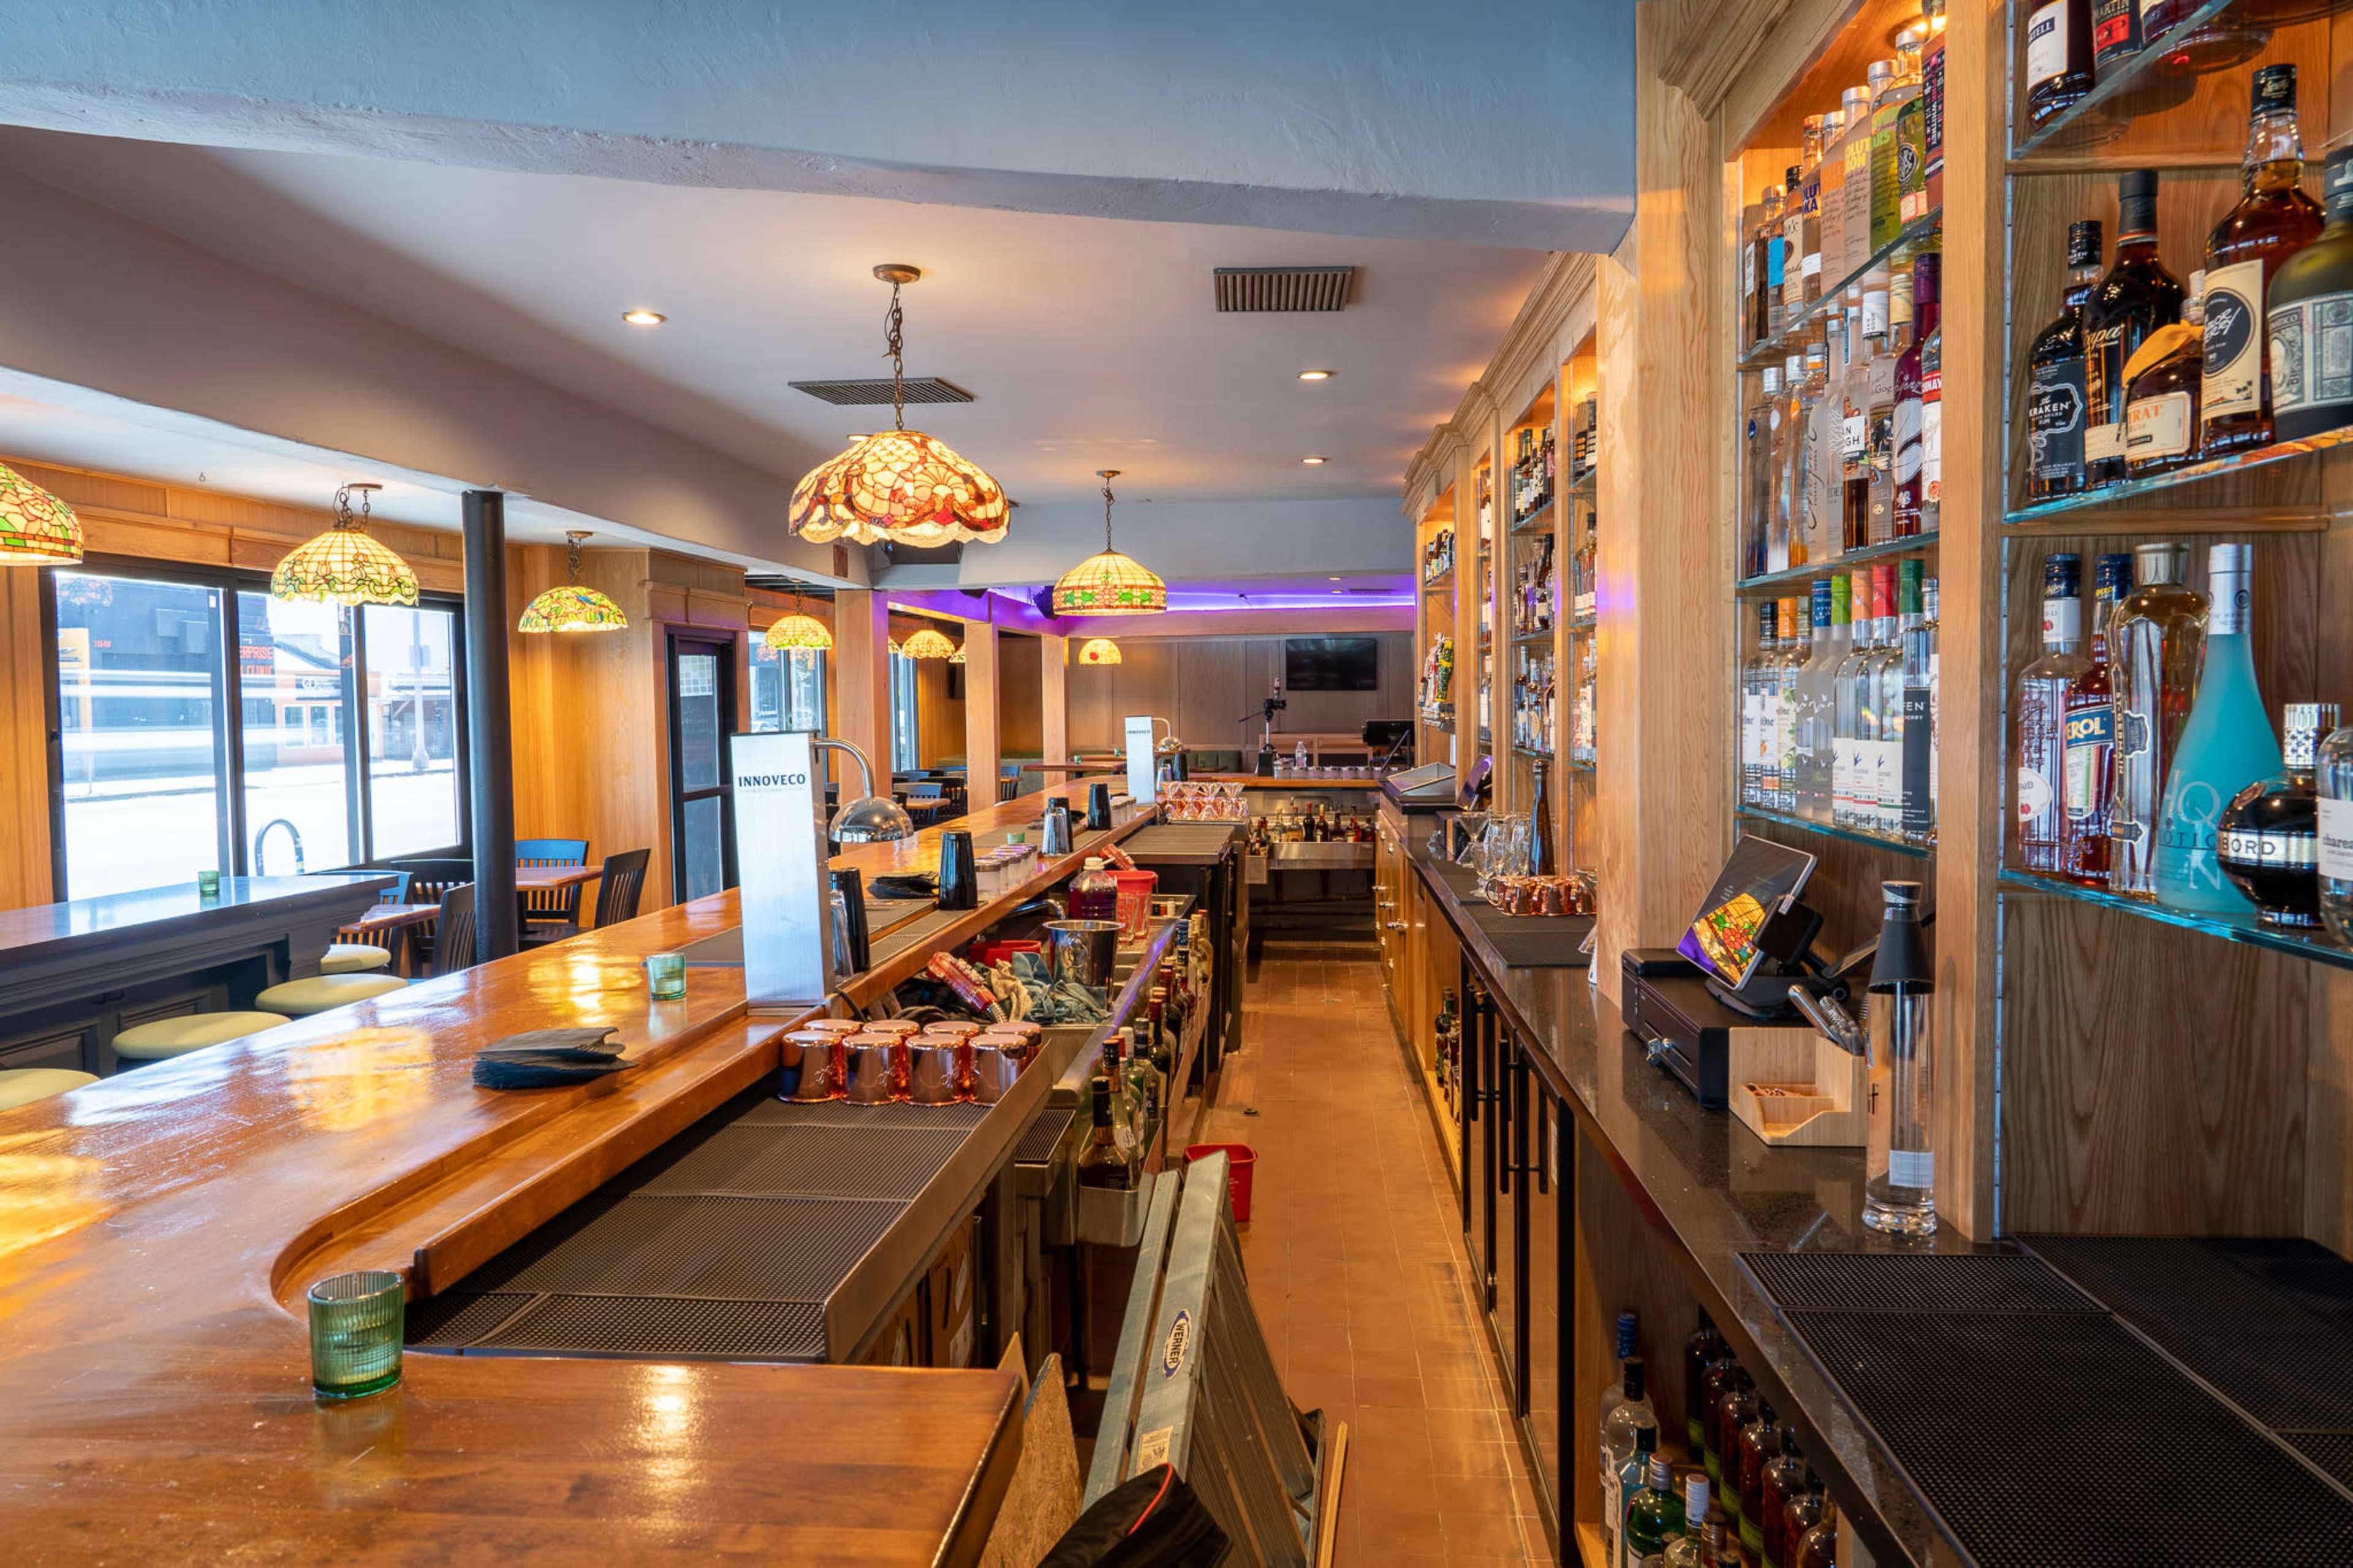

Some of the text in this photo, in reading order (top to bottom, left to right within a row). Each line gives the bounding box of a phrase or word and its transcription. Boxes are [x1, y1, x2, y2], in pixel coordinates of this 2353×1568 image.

[2029, 403, 2068, 418] KRAKEN
[2066, 717, 2105, 741] EROL
[2116, 692, 2124, 774] ST-GERMAIN
[738, 773, 806, 787] INNOVECO
[2222, 836, 2276, 856] BORD
[1169, 1323, 1186, 1365] WERNER
